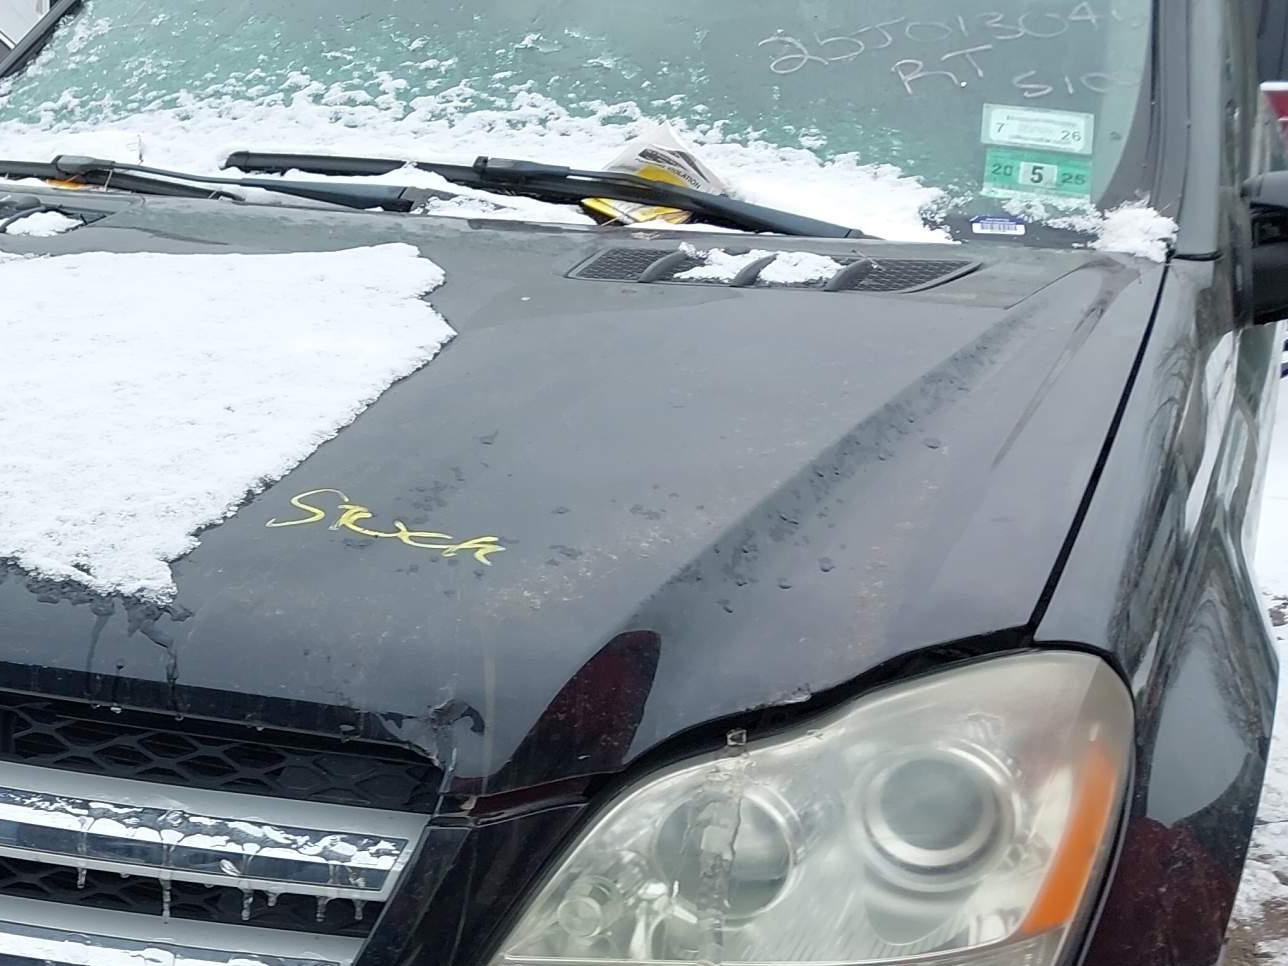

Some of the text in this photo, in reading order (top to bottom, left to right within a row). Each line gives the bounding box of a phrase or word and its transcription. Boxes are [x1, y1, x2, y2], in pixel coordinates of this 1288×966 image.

[1060, 130, 1082, 142] 26
[992, 163, 1086, 186] 20 5 25
